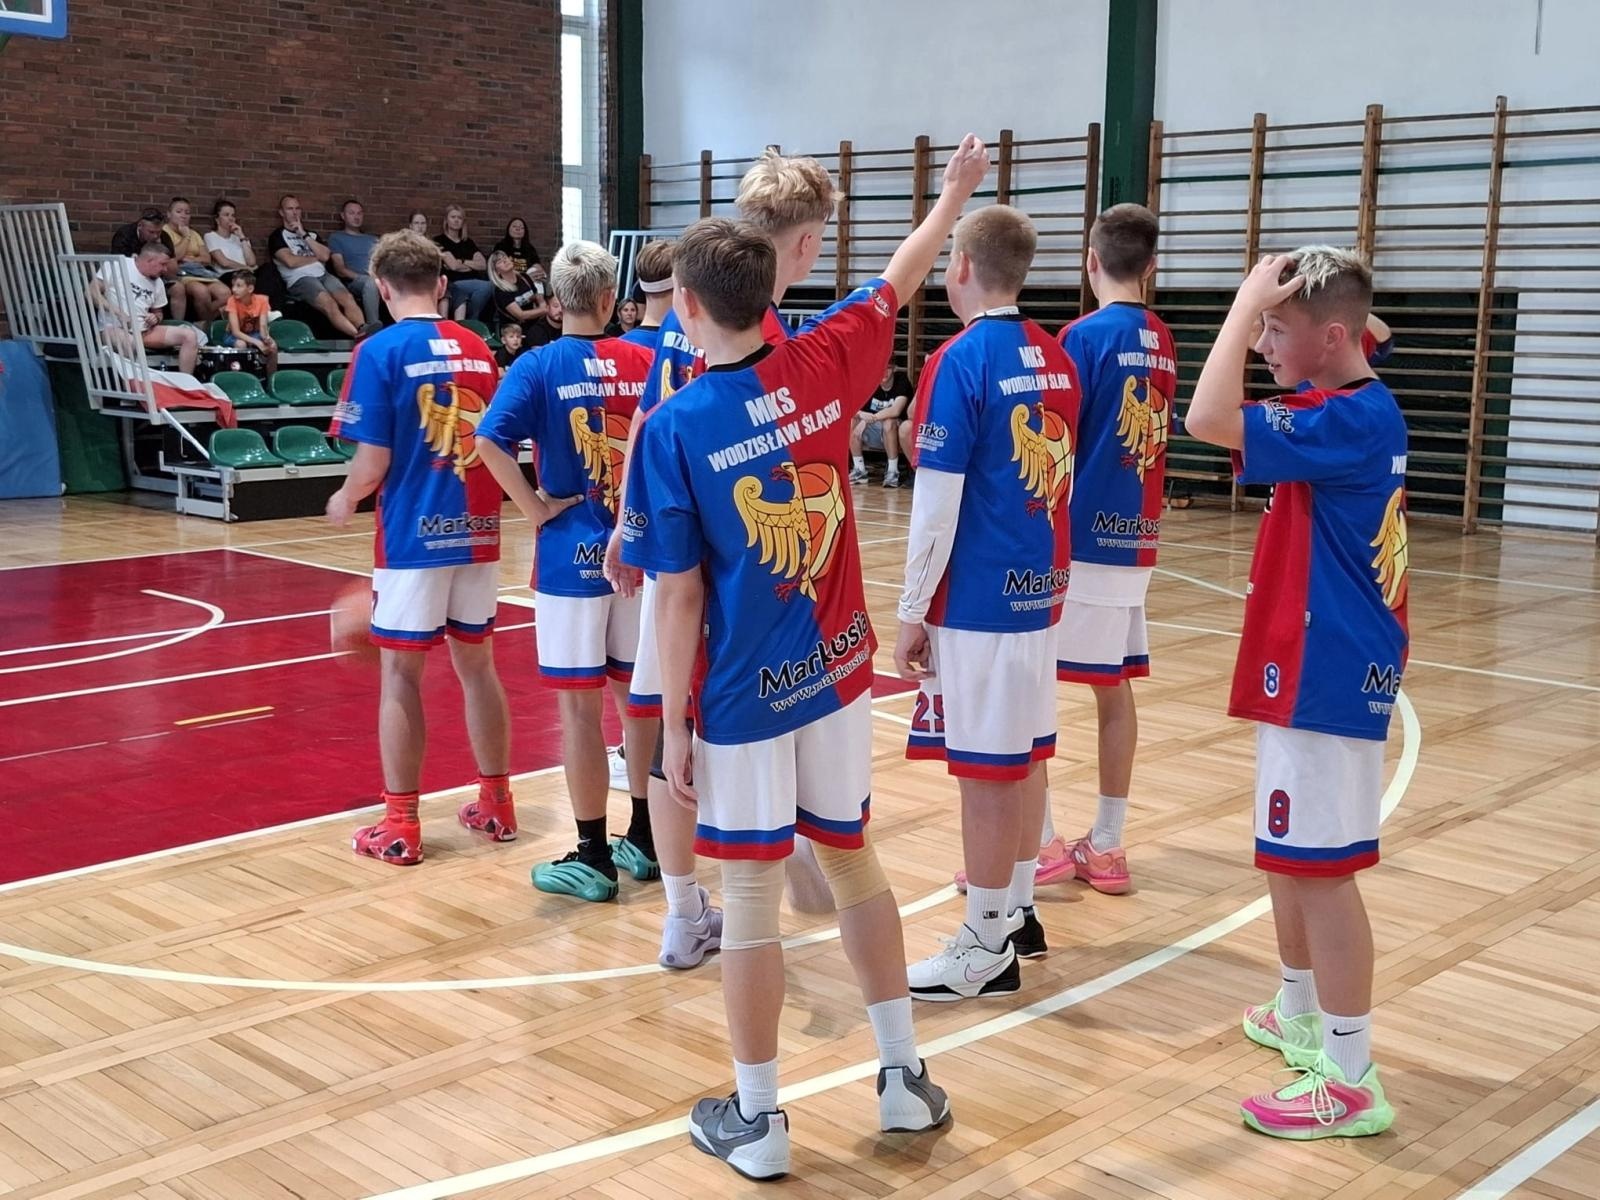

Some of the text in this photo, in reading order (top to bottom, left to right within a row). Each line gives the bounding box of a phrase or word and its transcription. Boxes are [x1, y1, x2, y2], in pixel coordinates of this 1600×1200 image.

[583, 357, 618, 378] MKS
[1018, 345, 1046, 369] MKS
[556, 381, 616, 400] WODZISŁAW
[745, 386, 797, 427] MKS
[707, 399, 841, 473] WODZISŁAW ŚLĄSKI
[758, 610, 869, 698] Markusia
[1264, 662, 1280, 698] 8
[1268, 789, 1291, 839] 8
